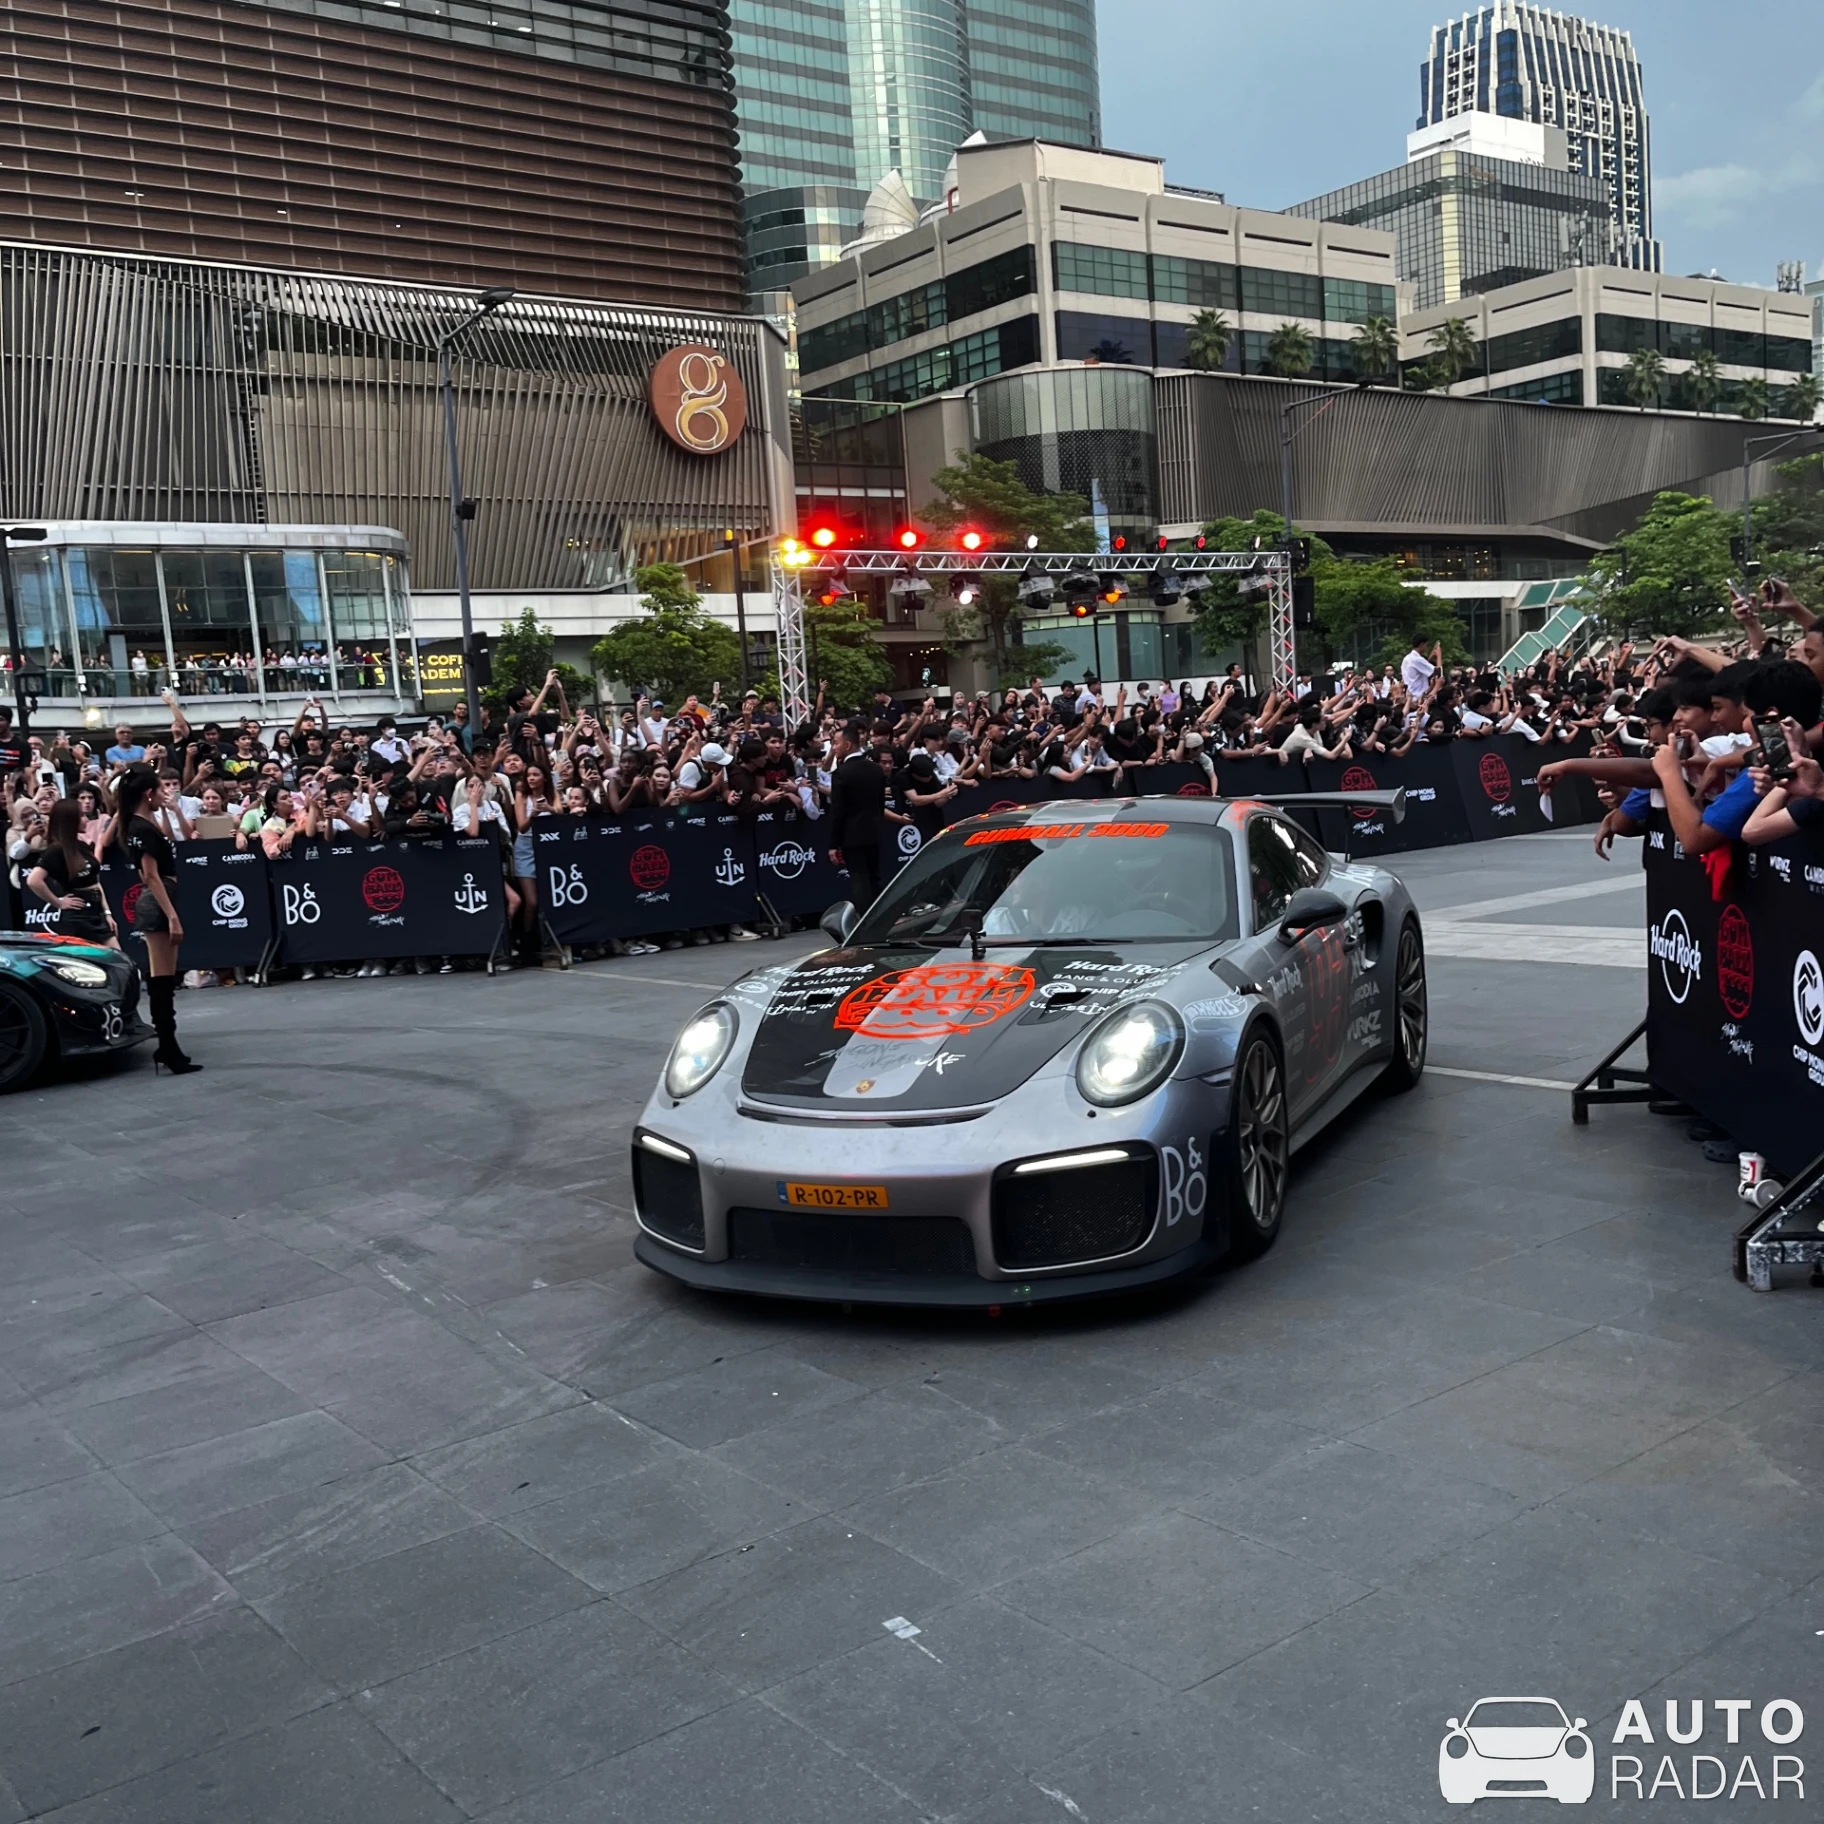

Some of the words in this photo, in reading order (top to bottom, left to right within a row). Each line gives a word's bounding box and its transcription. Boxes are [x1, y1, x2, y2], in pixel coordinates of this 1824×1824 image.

[963, 823, 1086, 847] GUMBALL
[1086, 822, 1170, 838] 3000
[759, 850, 788, 868] Hard
[788, 847, 816, 866] Rock
[25, 907, 62, 925] Hard
[1650, 923, 1676, 962] Hard
[1675, 932, 1702, 981] Rock
[1063, 960, 1133, 973] Hard
[1052, 973, 1095, 982] BANG
[794, 1186, 881, 1206] R-102-PR
